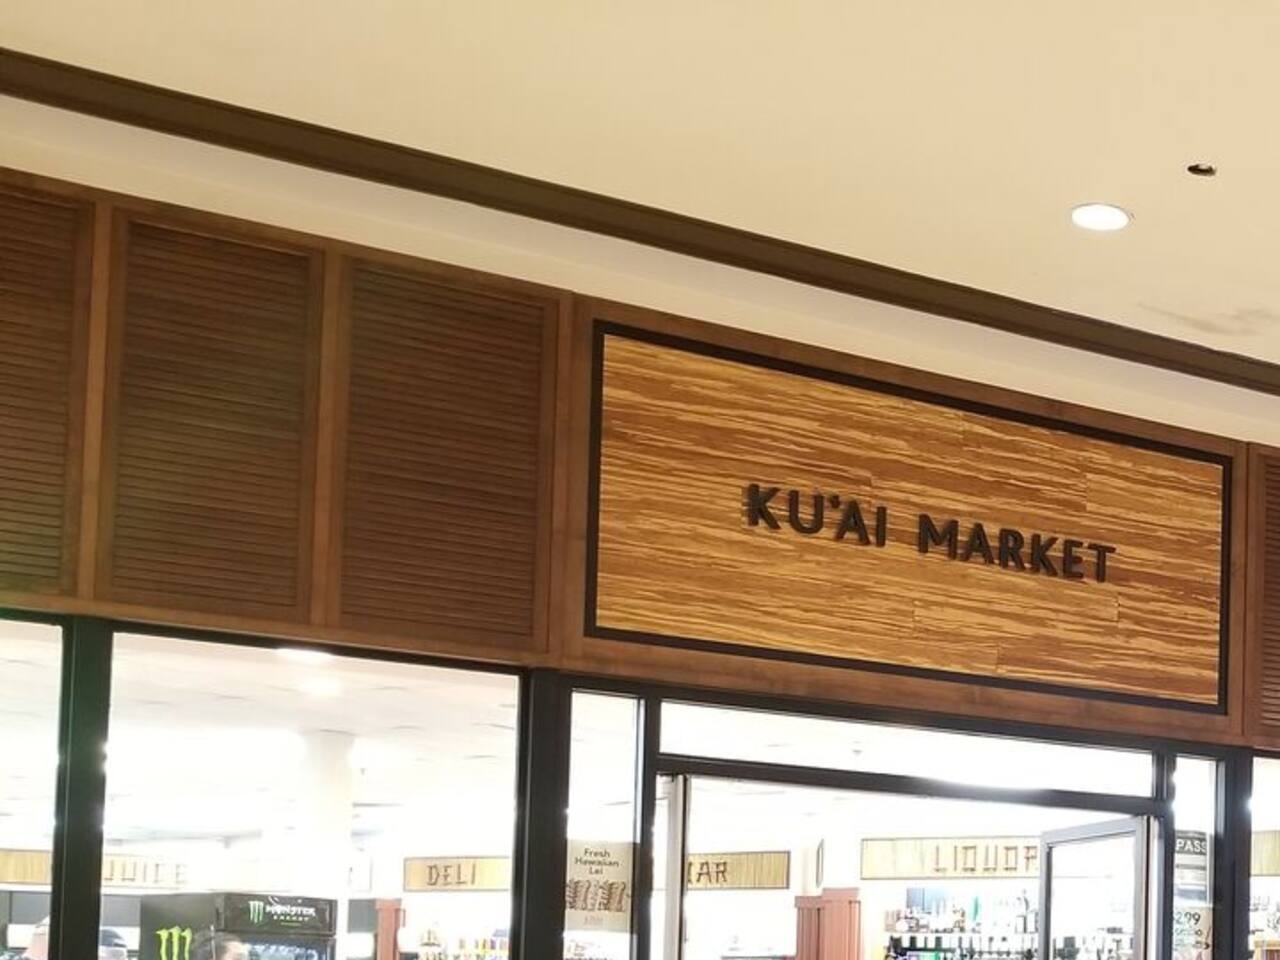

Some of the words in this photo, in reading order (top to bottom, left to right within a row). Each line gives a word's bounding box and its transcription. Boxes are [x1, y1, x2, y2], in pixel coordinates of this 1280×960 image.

[916, 513, 1117, 584] MARKET
[583, 847, 611, 858] Fresh
[574, 856, 619, 868] Hawaiian
[426, 862, 477, 886] DELI
[588, 866, 603, 875] Lei
